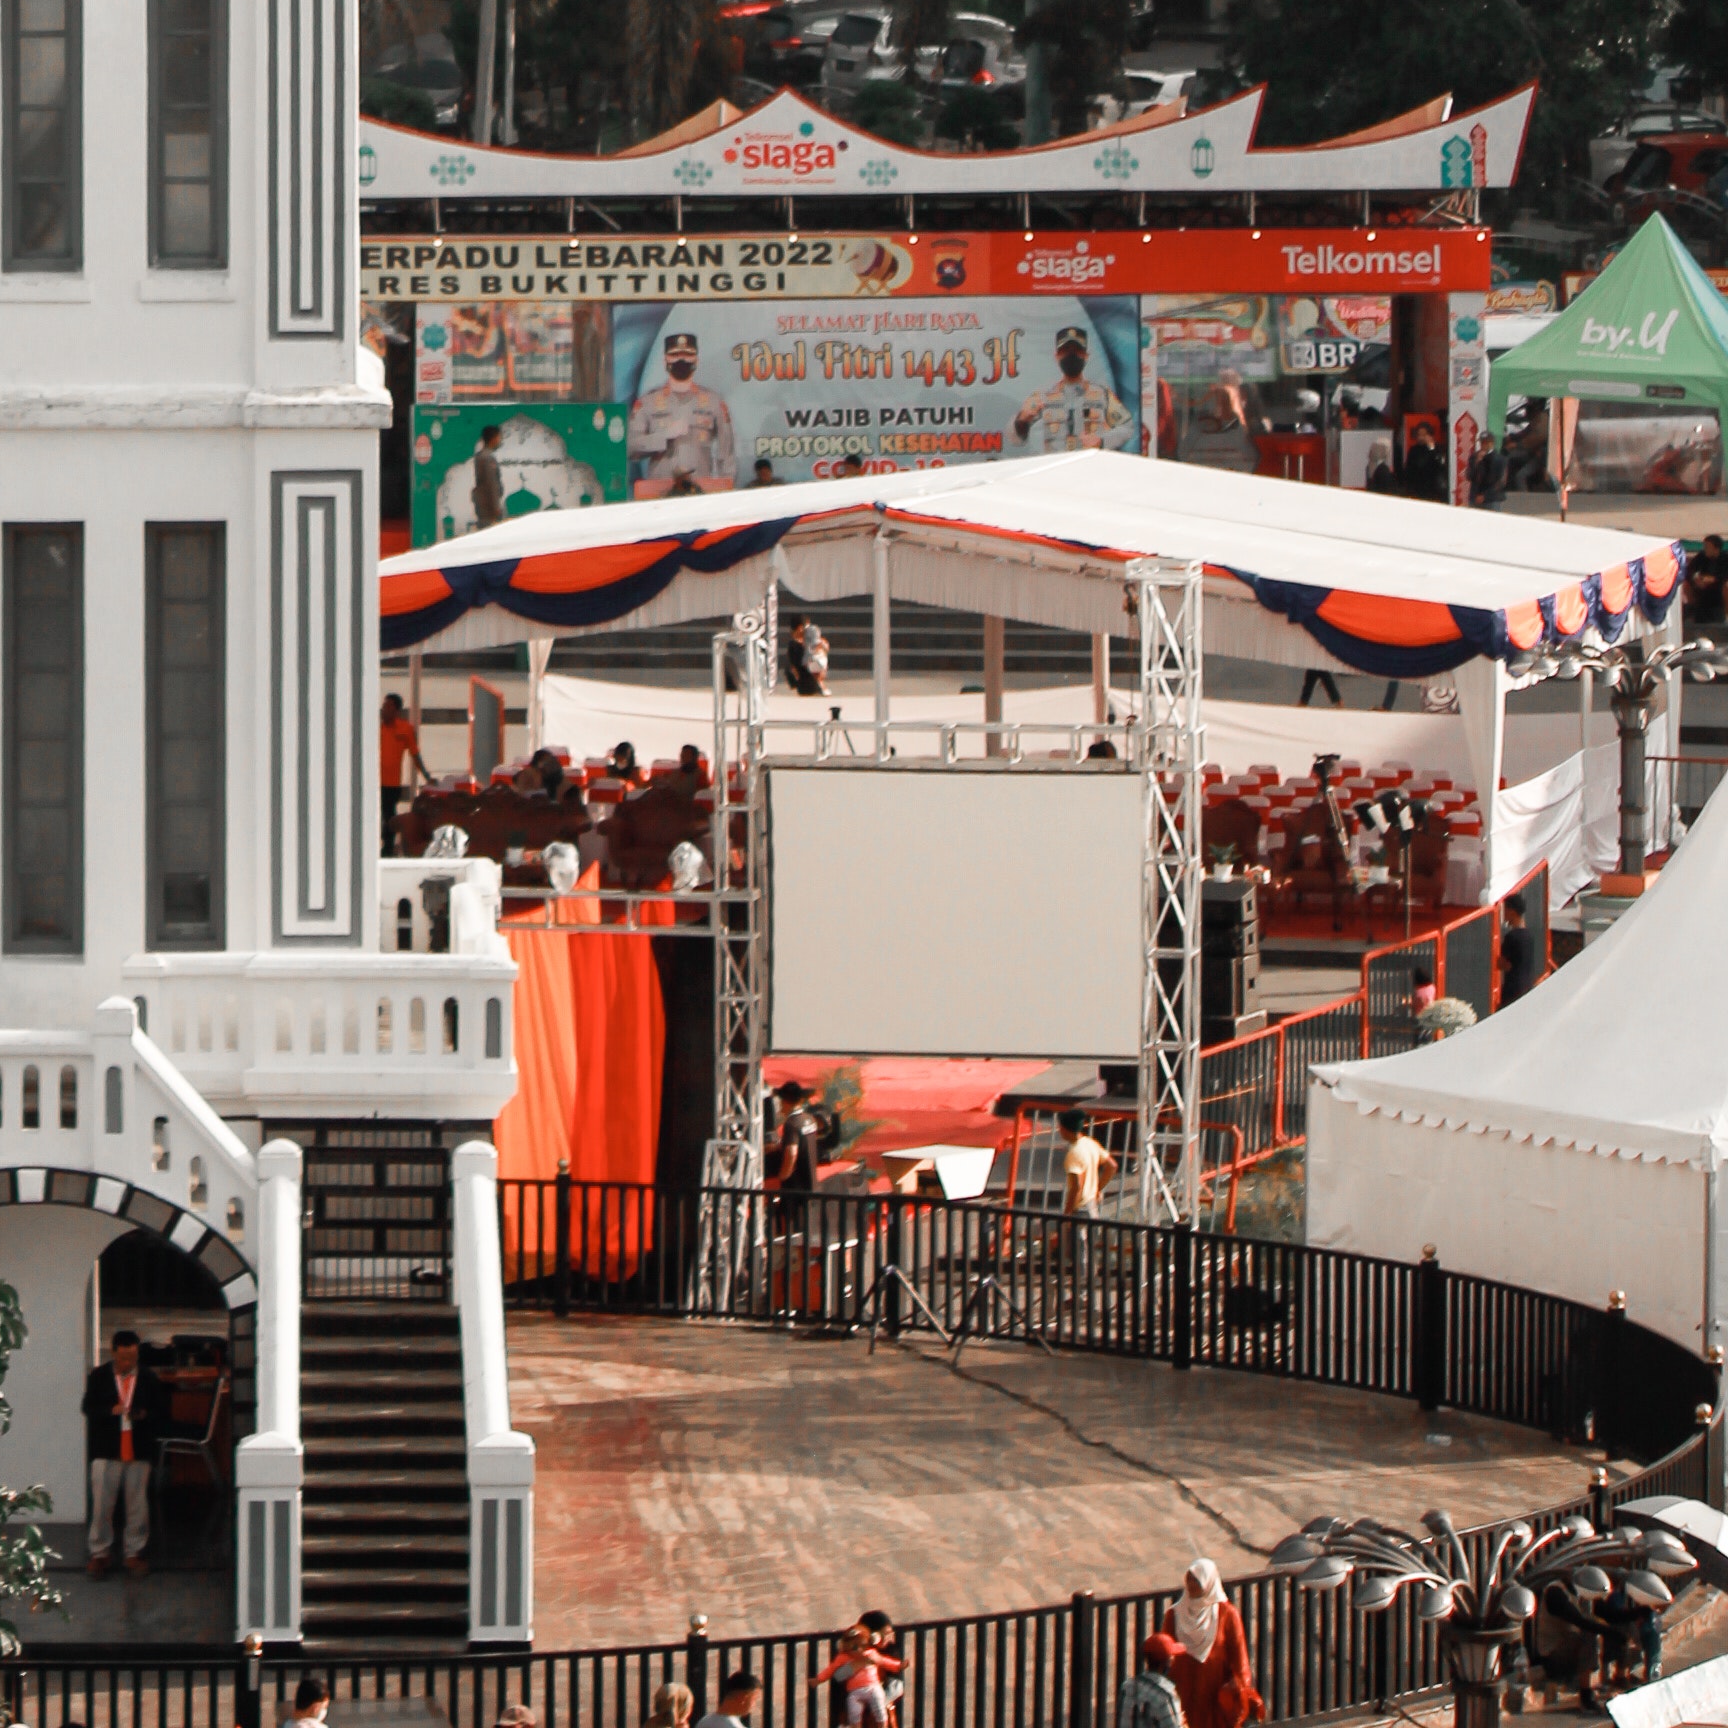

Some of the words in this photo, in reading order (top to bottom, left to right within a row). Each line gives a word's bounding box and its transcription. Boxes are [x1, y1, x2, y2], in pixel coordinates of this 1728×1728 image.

[742, 141, 836, 175] siaga
[535, 244, 725, 269] LEBARAN
[738, 242, 834, 267] 2022
[1280, 244, 1441, 274] Telkomsel
[361, 275, 460, 294] RES
[481, 272, 786, 294] BUKITTINGGI
[1032, 256, 1106, 283] siaga
[776, 313, 869, 334] SELAMAT
[871, 311, 925, 334] HARI
[929, 311, 983, 334] RAYA
[1579, 309, 1680, 356] by.U
[732, 340, 807, 381] Idul
[815, 340, 893, 380] Fitri
[901, 349, 977, 387] 1443
[982, 328, 1025, 385] H
[1319, 342, 1367, 368] BR
[785, 409, 870, 427] WAJIB
[879, 406, 973, 426] PATUHI
[755, 435, 872, 457] PROTOKOL
[879, 432, 1003, 455] KESEHATAN
